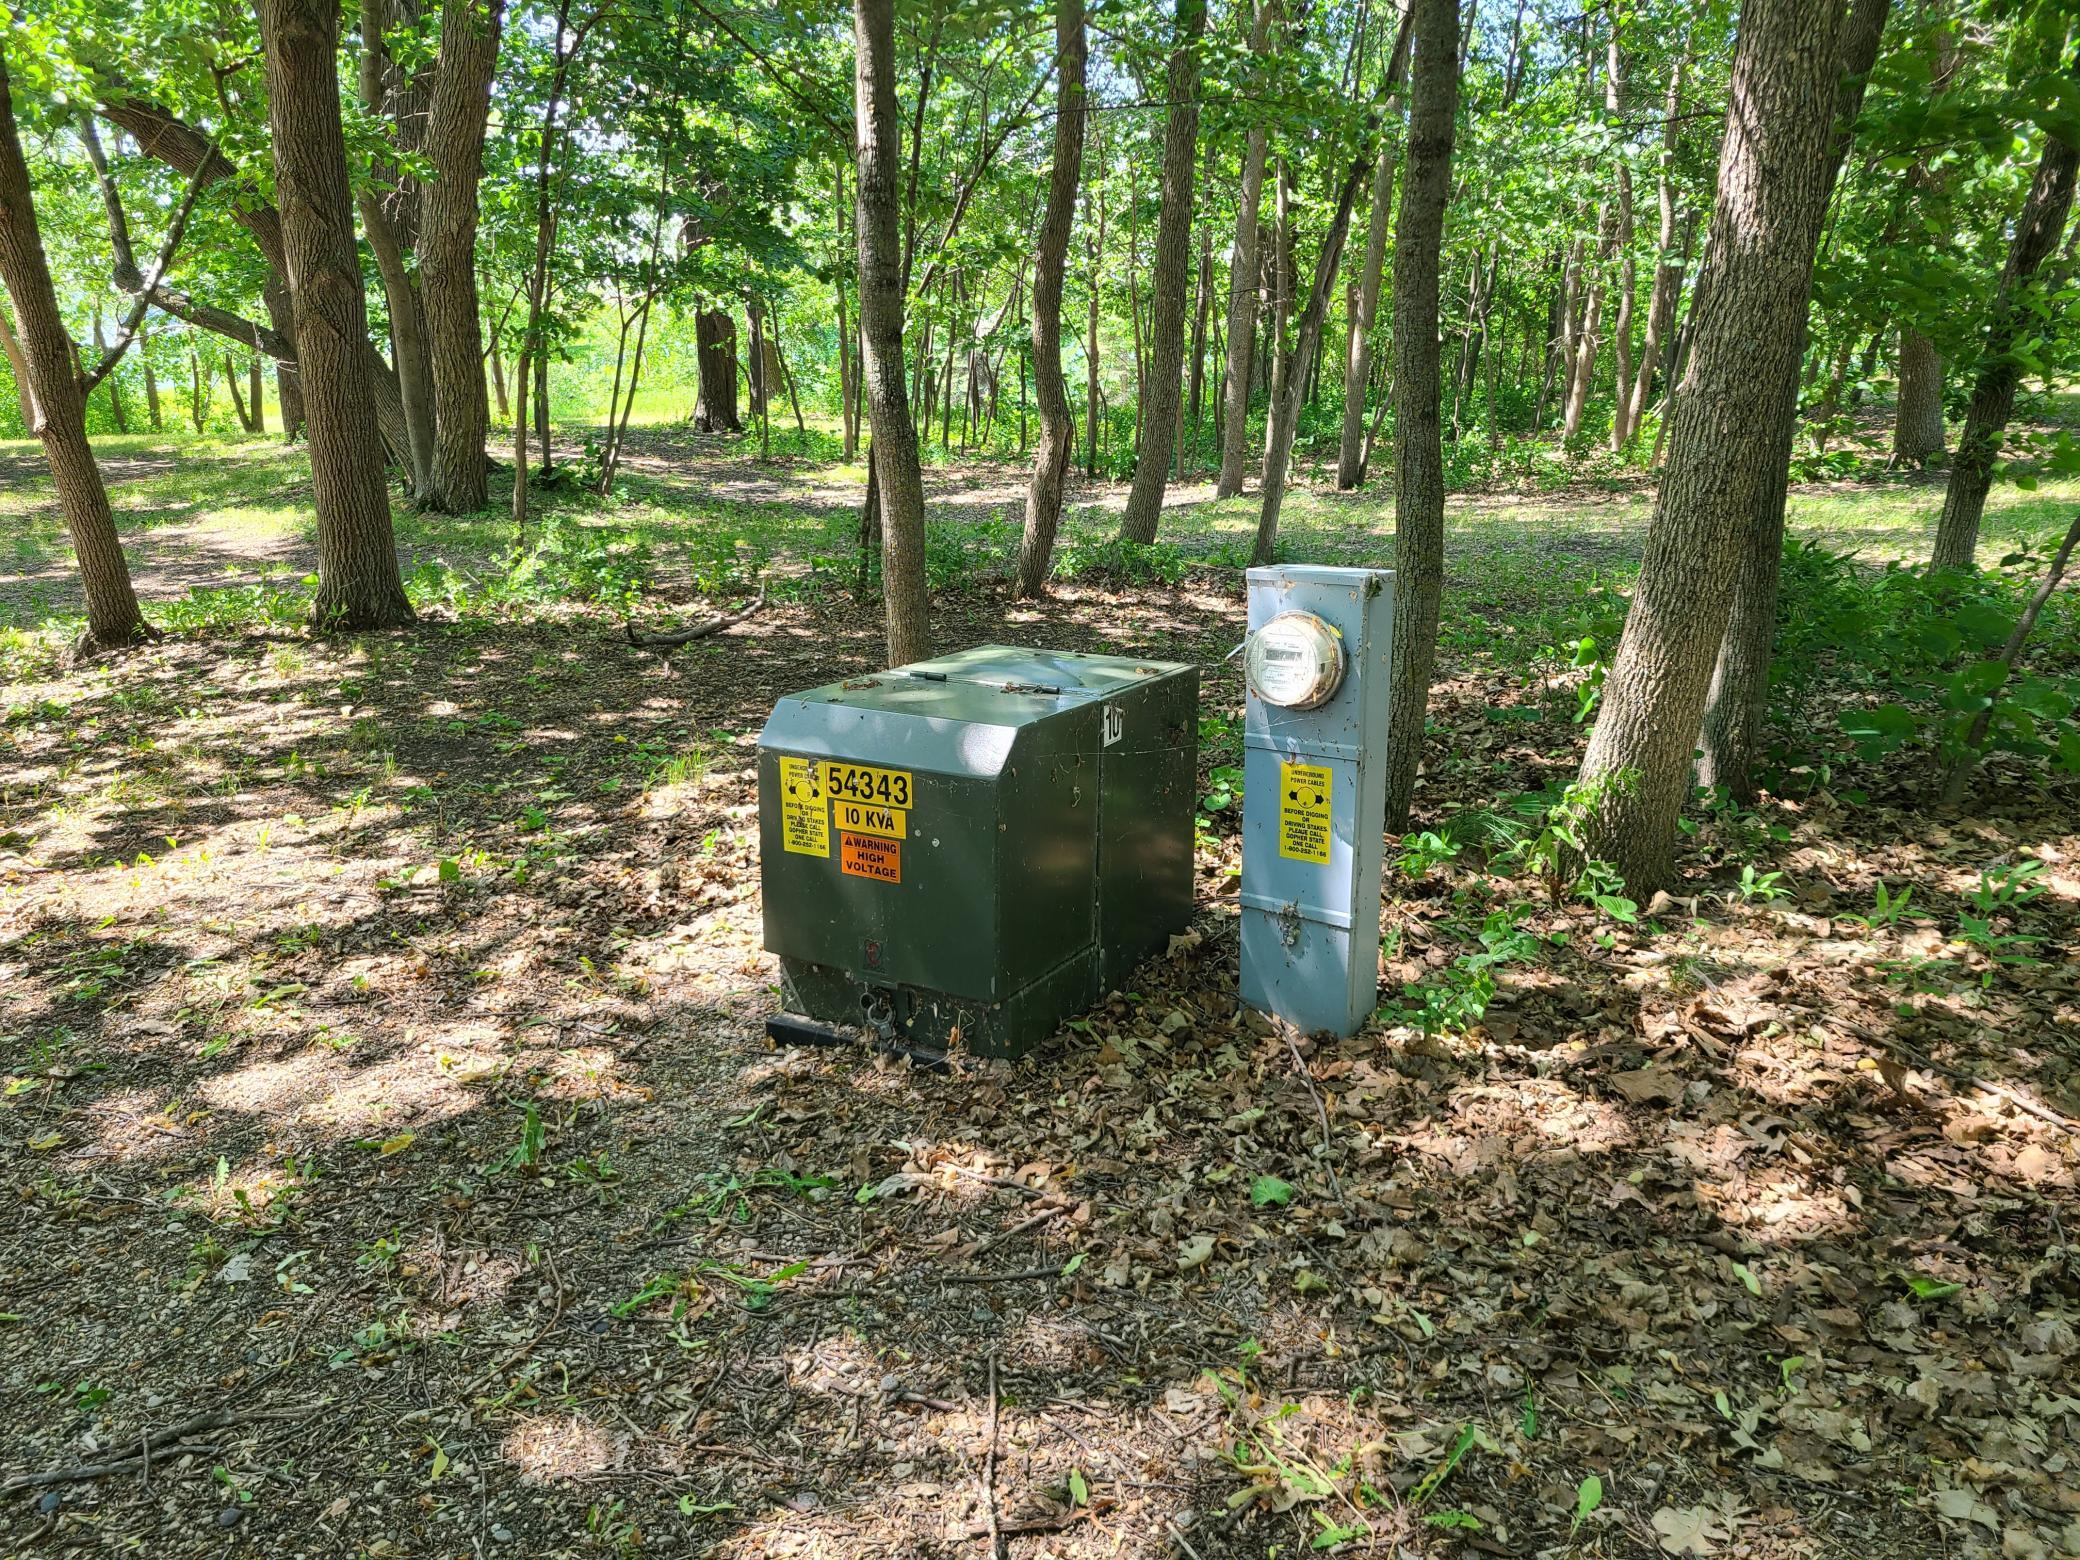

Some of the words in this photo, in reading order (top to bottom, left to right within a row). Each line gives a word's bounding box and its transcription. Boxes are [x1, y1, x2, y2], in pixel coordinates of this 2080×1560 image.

[828, 767, 909, 805] 54343
[785, 802, 804, 810] BEFORE
[805, 805, 825, 813] DIGGING
[845, 807, 860, 825] 10
[866, 810, 895, 831] KVA
[1284, 808, 1305, 816] BEFORE
[1306, 811, 1328, 820] DIGGING
[790, 821, 808, 829] PLEASE
[1284, 820, 1306, 828] DRIVING
[788, 827, 808, 835] GOPHER
[1288, 827, 1308, 835] PLEASE
[1286, 833, 1308, 841] GOPHER
[853, 837, 897, 854] WARNING
[857, 851, 885, 864] HIGH
[846, 860, 897, 878] VOLTAGE
